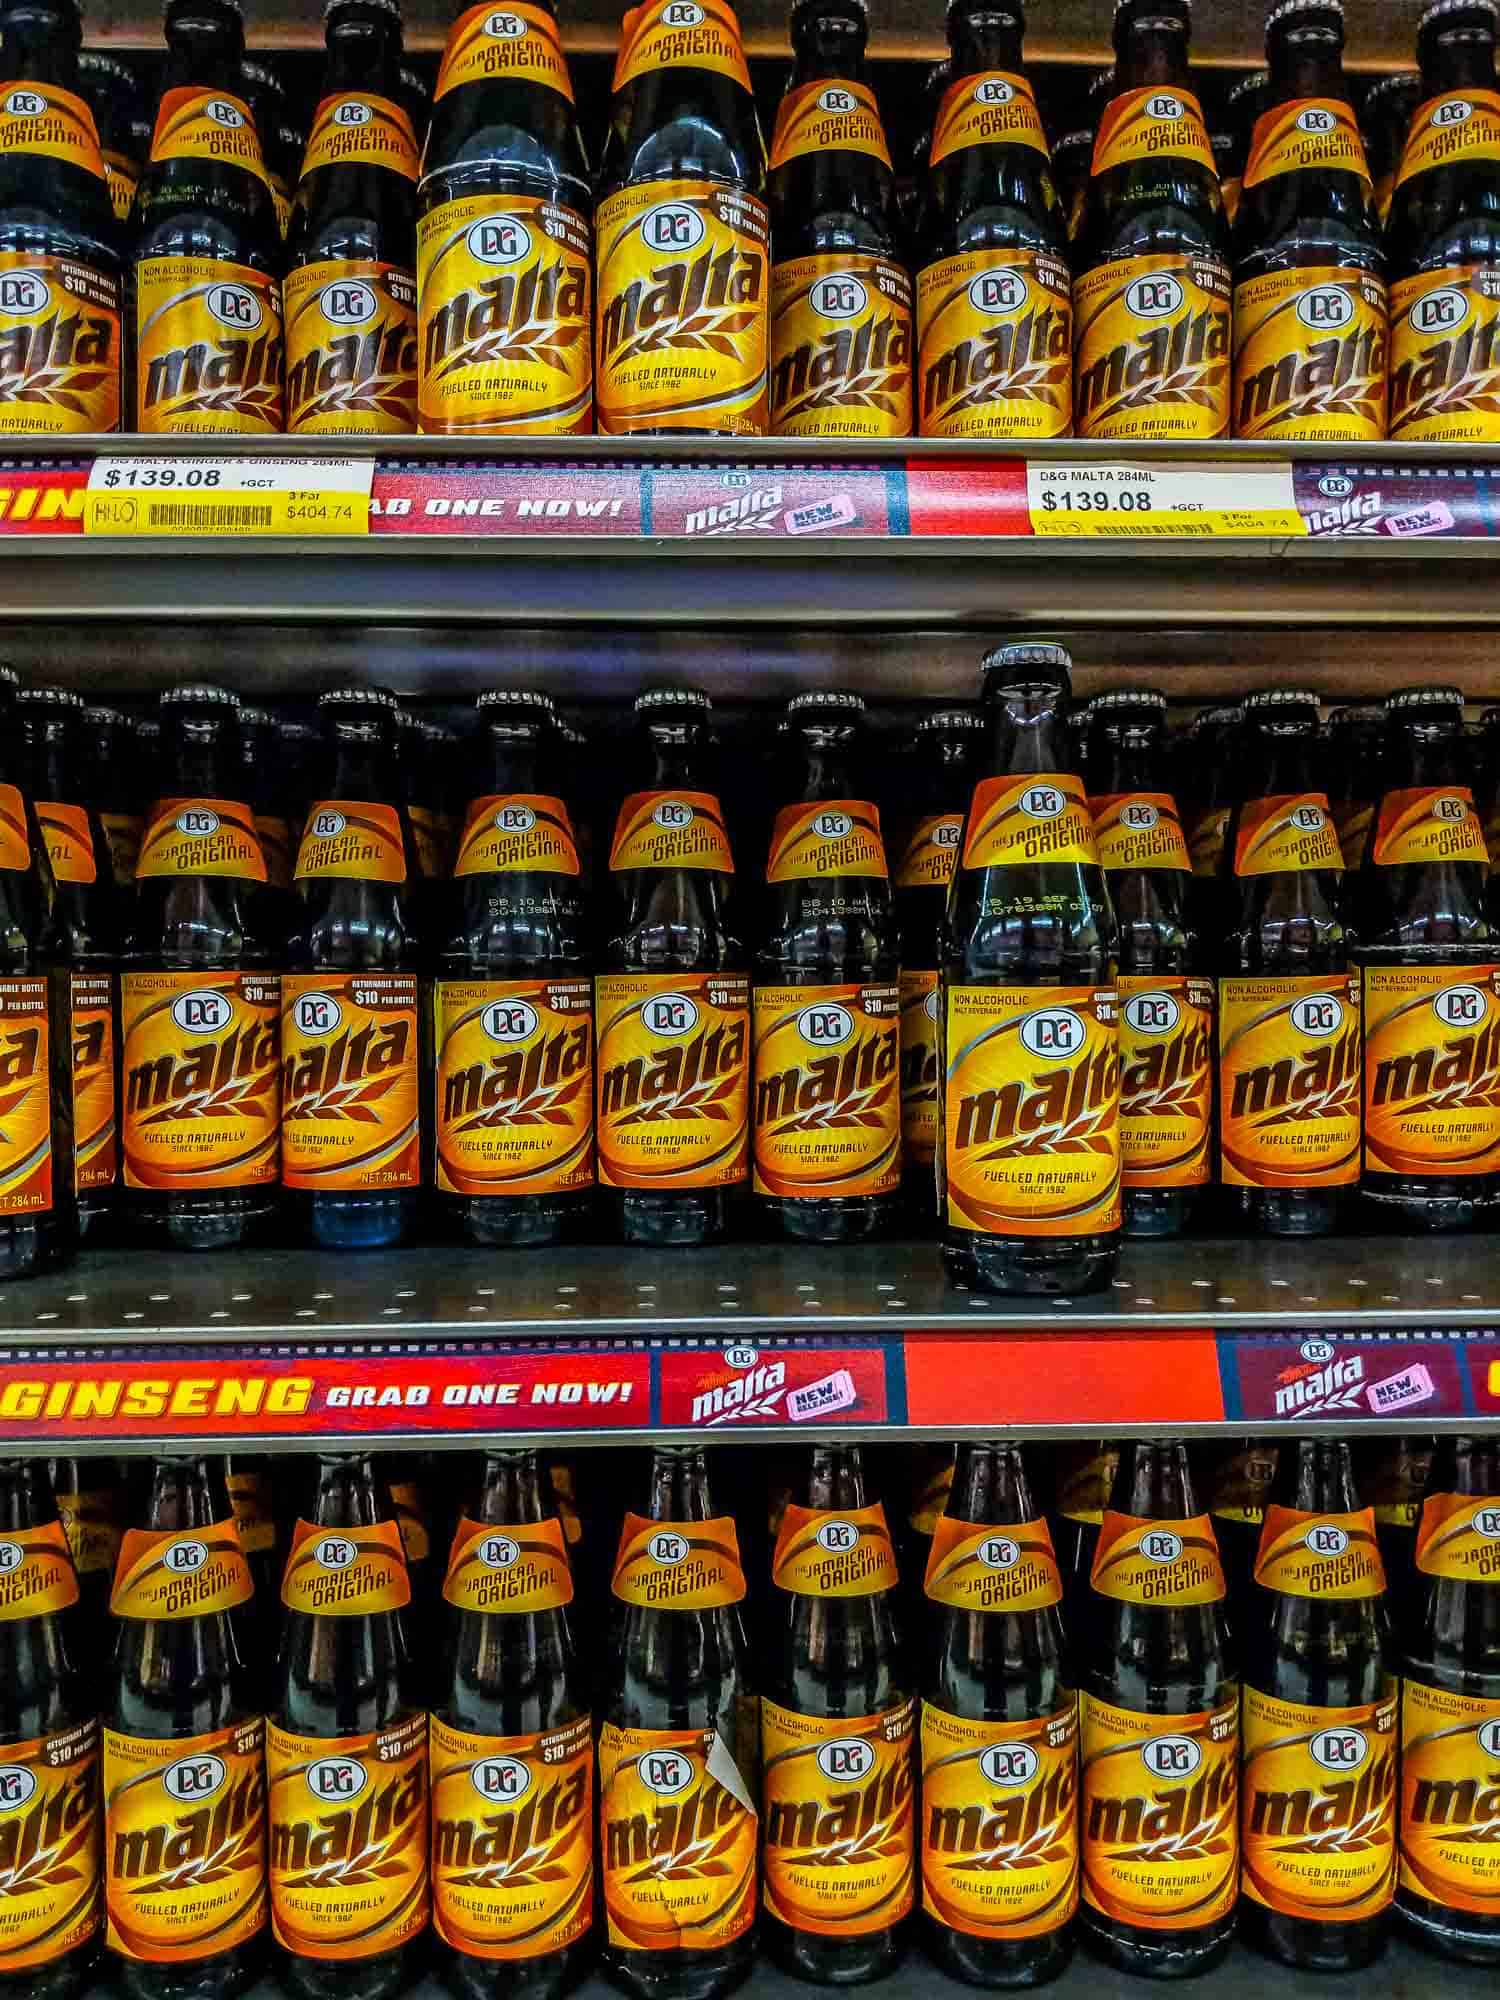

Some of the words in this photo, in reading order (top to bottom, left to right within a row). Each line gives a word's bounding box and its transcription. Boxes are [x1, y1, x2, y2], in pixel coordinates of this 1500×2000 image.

[545, 221, 566, 240] $10
[655, 214, 690, 244] DG
[481, 226, 517, 257] DG
[823, 284, 854, 311] DG
[982, 279, 1016, 306] DG
[1138, 282, 1171, 310] DG
[602, 241, 762, 367] malta
[423, 256, 586, 380] malta
[925, 304, 1064, 411] malta
[653, 367, 717, 380] NATURALLY
[441, 379, 482, 396] FUELLED
[484, 378, 548, 392] NATURALLY
[104, 469, 221, 488] $139.08
[240, 480, 275, 488] +GCT
[1040, 471, 1068, 482] D&G
[1071, 471, 1114, 482] MALTA
[1118, 471, 1155, 482] 284ML
[424, 498, 505, 516] ONE
[517, 499, 623, 517] NOW!
[685, 486, 784, 534] malta
[1042, 490, 1153, 512] $139.08
[1370, 975, 1388, 985] NON
[1390, 975, 1441, 985] ALCOHOLIC
[245, 988, 263, 1001] $10
[356, 991, 378, 1004] $10
[551, 996, 569, 1010] $10
[972, 995, 1030, 1006] ALCOHOLIC
[185, 999, 219, 1025] DG
[493, 1008, 525, 1035] DG
[654, 1003, 685, 1029] DG
[810, 1013, 840, 1038] DG
[1036, 1019, 1072, 1049] DG
[128, 1017, 278, 1112] malta
[444, 1023, 588, 1122] malta
[602, 1018, 745, 1117] malta
[756, 1028, 898, 1126] malta
[185, 1132, 245, 1143] NATURALLY
[655, 1134, 712, 1145] NATURALLY
[1400, 1123, 1444, 1134] FUELLED
[496, 1140, 553, 1152] NATURALLY
[1260, 1135, 1303, 1146] FUELLED
[984, 1170, 1033, 1184] FUELLED
[1036, 1171, 1097, 1184] NATURALLY
[1019, 1185, 1044, 1194] SINCE
[1046, 1185, 1066, 1194] 1982
[691, 1362, 785, 1422] malta
[796, 1382, 833, 1404] NEW
[1274, 1355, 1363, 1414] malta
[1375, 1376, 1412, 1398] NEW
[0, 1378, 314, 1419] GINSENG
[326, 1385, 431, 1406] GRAB
[442, 1384, 521, 1405] ONE
[530, 1382, 633, 1405] NOW!
[1431, 1694, 1489, 1713] ALCOHOLIC
[380, 1742, 401, 1760] $10
[544, 1744, 565, 1762] $10
[831, 1747, 862, 1774] DG
[994, 1751, 1026, 1778] DG
[177, 1763, 213, 1793] DG
[319, 1766, 353, 1793] DG
[484, 1765, 517, 1794] DG
[272, 1769, 421, 1869] malta
[436, 1764, 587, 1866] malta
[1277, 1861, 1320, 1877] FUELLED
[1439, 1850, 1480, 1867] FUELLED
[1112, 1867, 1154, 1885] FUELLED
[996, 1880, 1051, 1897] NATURALLY
[135, 1902, 177, 1916] FUELLED
[181, 1888, 240, 1912] NATURALLY
[326, 1895, 385, 1913] NATURALLY
[487, 1899, 545, 1915] NATURALLY
